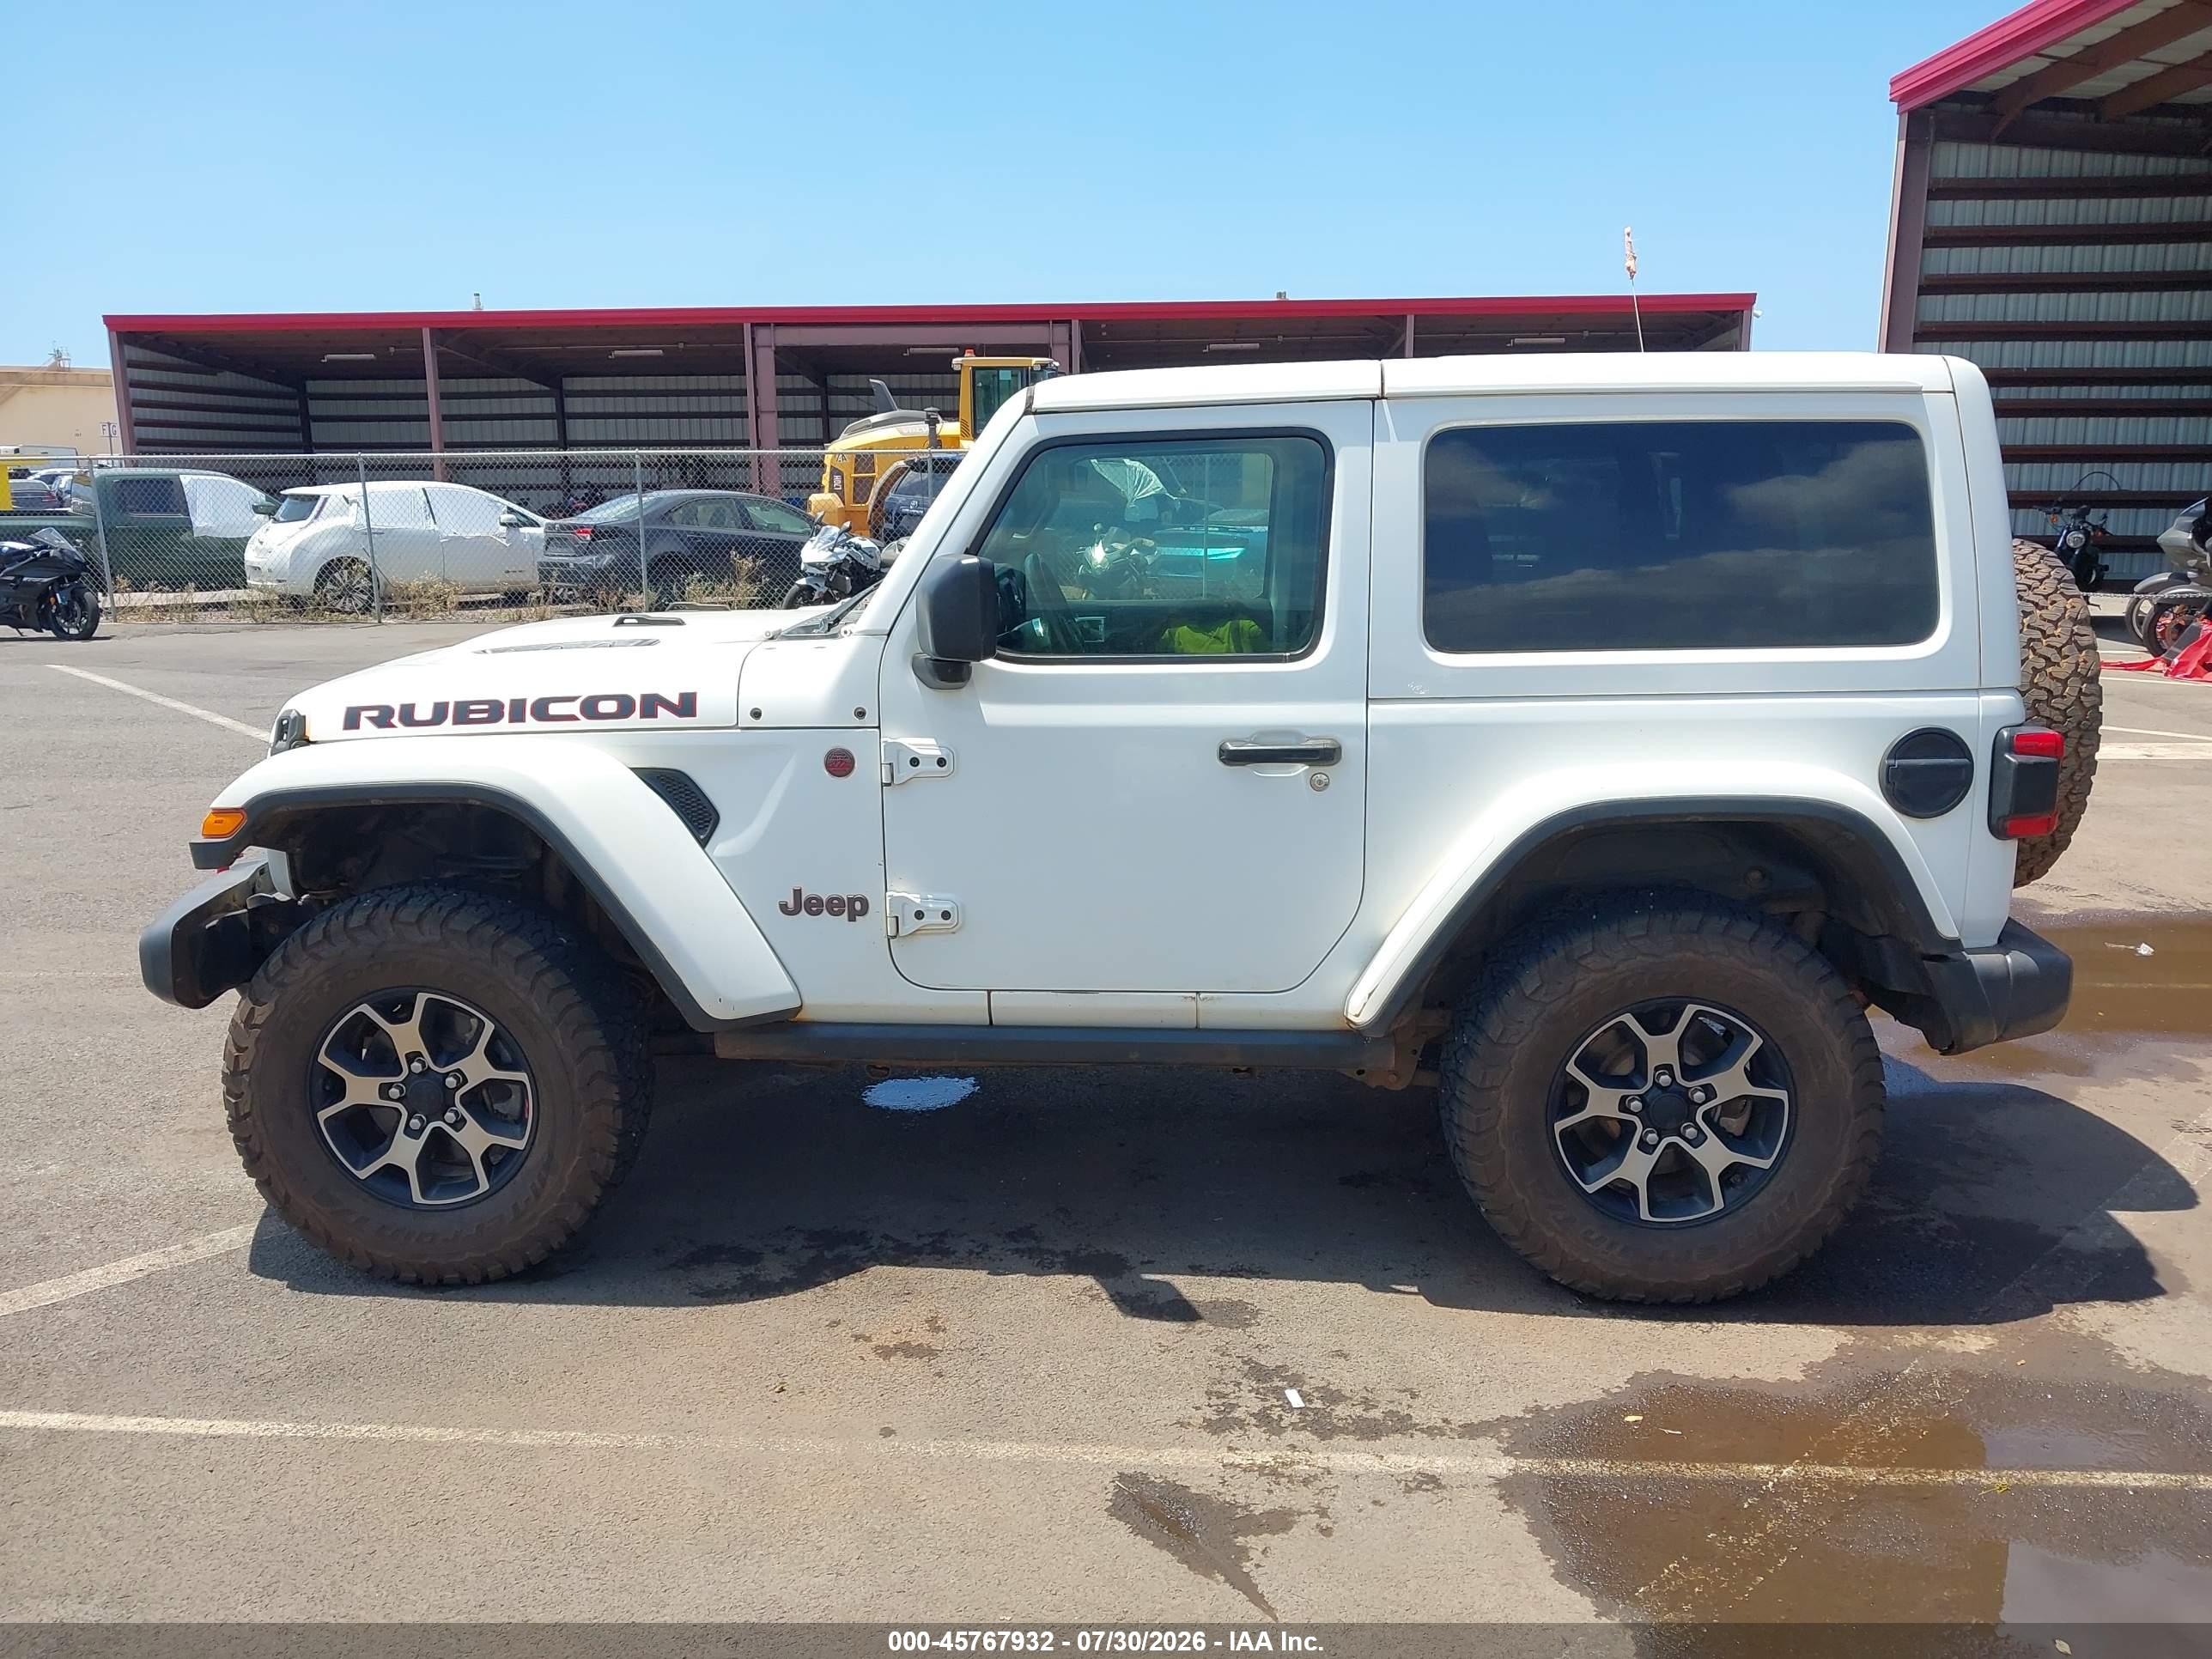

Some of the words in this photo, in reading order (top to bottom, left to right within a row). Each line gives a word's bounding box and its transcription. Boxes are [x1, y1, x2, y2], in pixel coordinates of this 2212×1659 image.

[101, 424, 107, 435] F
[112, 424, 118, 436] G
[342, 691, 698, 732] RUBICON
[778, 886, 870, 922] Jeep
